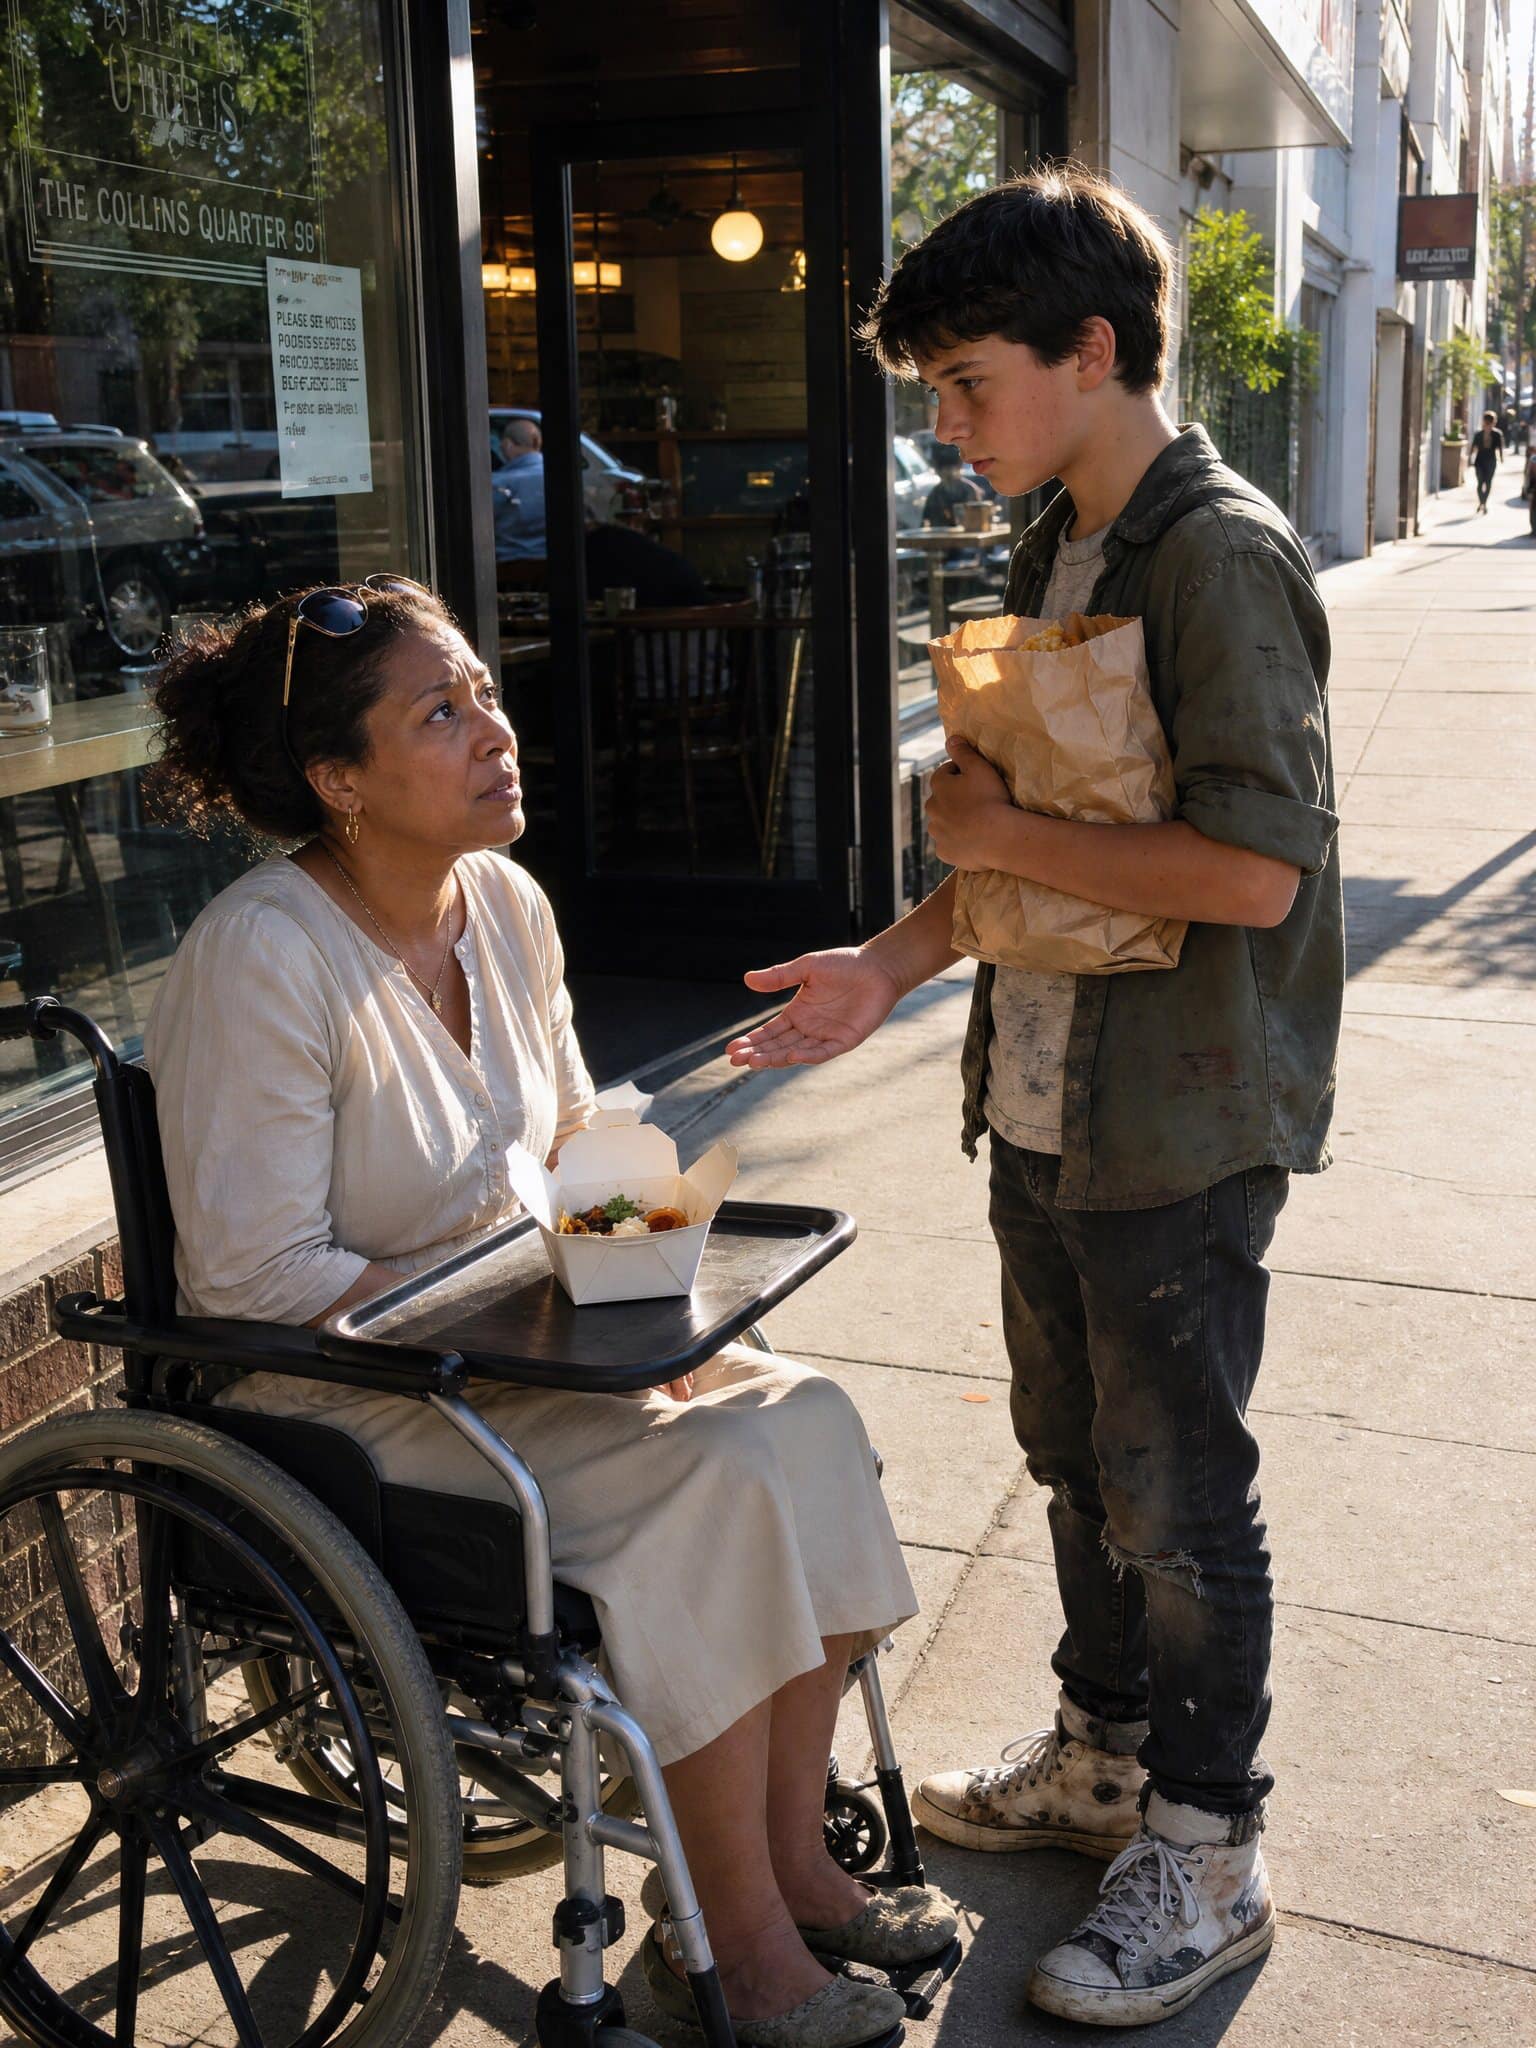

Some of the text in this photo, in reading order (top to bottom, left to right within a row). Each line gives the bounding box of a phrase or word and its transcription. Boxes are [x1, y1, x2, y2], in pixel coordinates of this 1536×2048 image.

[40, 178, 88, 221] THE
[97, 187, 190, 236] COLLINS
[199, 204, 287, 250] QUARTER
[276, 311, 308, 328] PLEASE
[310, 314, 324, 329] SEE
